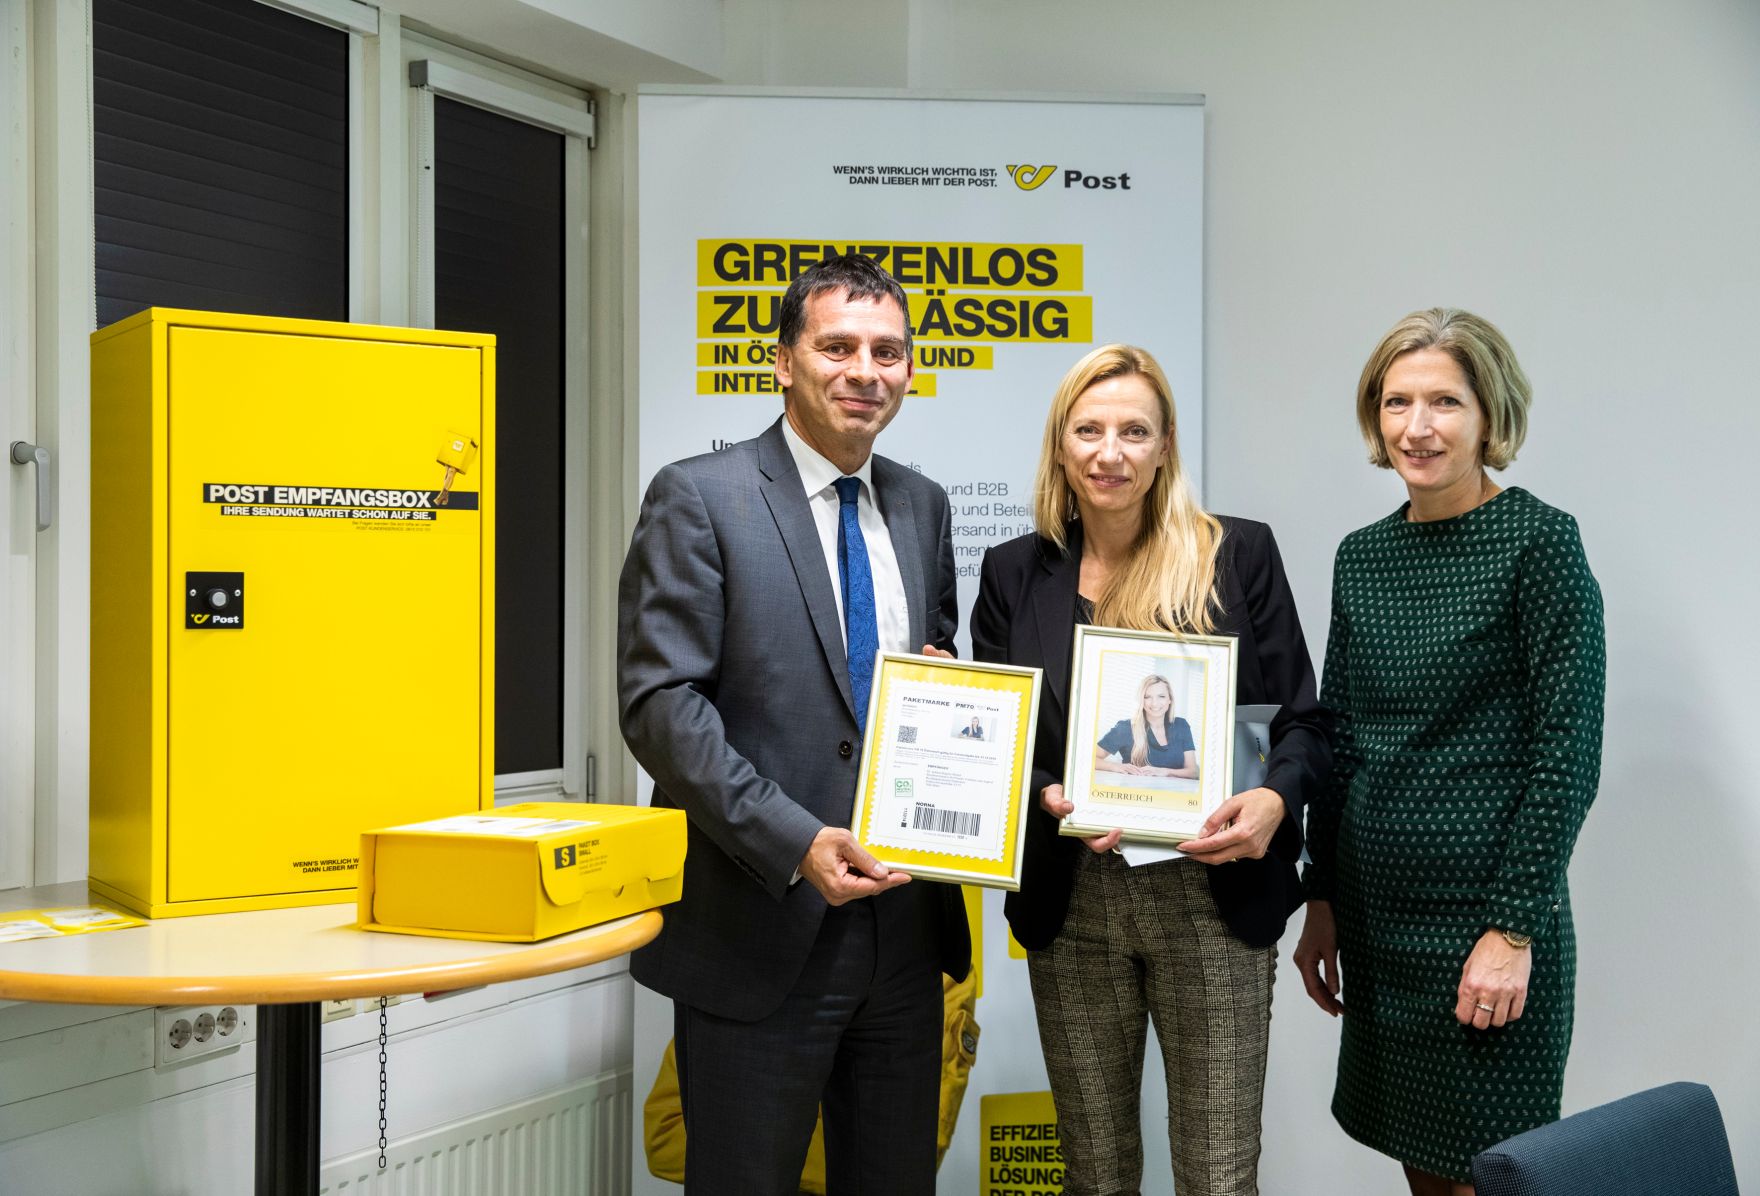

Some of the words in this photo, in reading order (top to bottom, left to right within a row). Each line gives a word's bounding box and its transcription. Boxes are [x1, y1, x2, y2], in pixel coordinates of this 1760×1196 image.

[833, 165, 875, 175] WENN'S
[877, 166, 929, 176] WIRKLICH
[931, 167, 977, 176] WICHTIG
[979, 168, 998, 178] IST,
[849, 176, 879, 185] DANN
[881, 176, 919, 186] LIEBER
[921, 177, 941, 186] MIT
[943, 178, 965, 187] DER
[968, 178, 998, 188] POST.
[1064, 170, 1131, 190] Post
[714, 344, 739, 365] IN
[920, 347, 975, 367] UND
[977, 482, 1009, 496] B2B
[209, 485, 269, 503] POST
[273, 487, 432, 508] EMPFANGSBOX
[223, 506, 250, 516] IHRE
[252, 507, 305, 517] SENDUNG
[306, 508, 350, 518] WARTET
[352, 509, 389, 519] SCHON
[390, 511, 411, 520] AUF
[412, 511, 432, 520] SIE.
[962, 502, 989, 516] und
[951, 523, 997, 537] ersand
[1001, 523, 1013, 537] in
[212, 615, 240, 624] Post
[902, 696, 950, 707] PAKETMARKE
[1091, 788, 1153, 803] ÖSTERREICH
[1187, 799, 1198, 807] 80
[292, 860, 319, 868] WENN'S
[320, 858, 352, 866] WIRKLICH
[561, 847, 570, 867] S
[989, 1124, 1059, 1141] EFFIZIE
